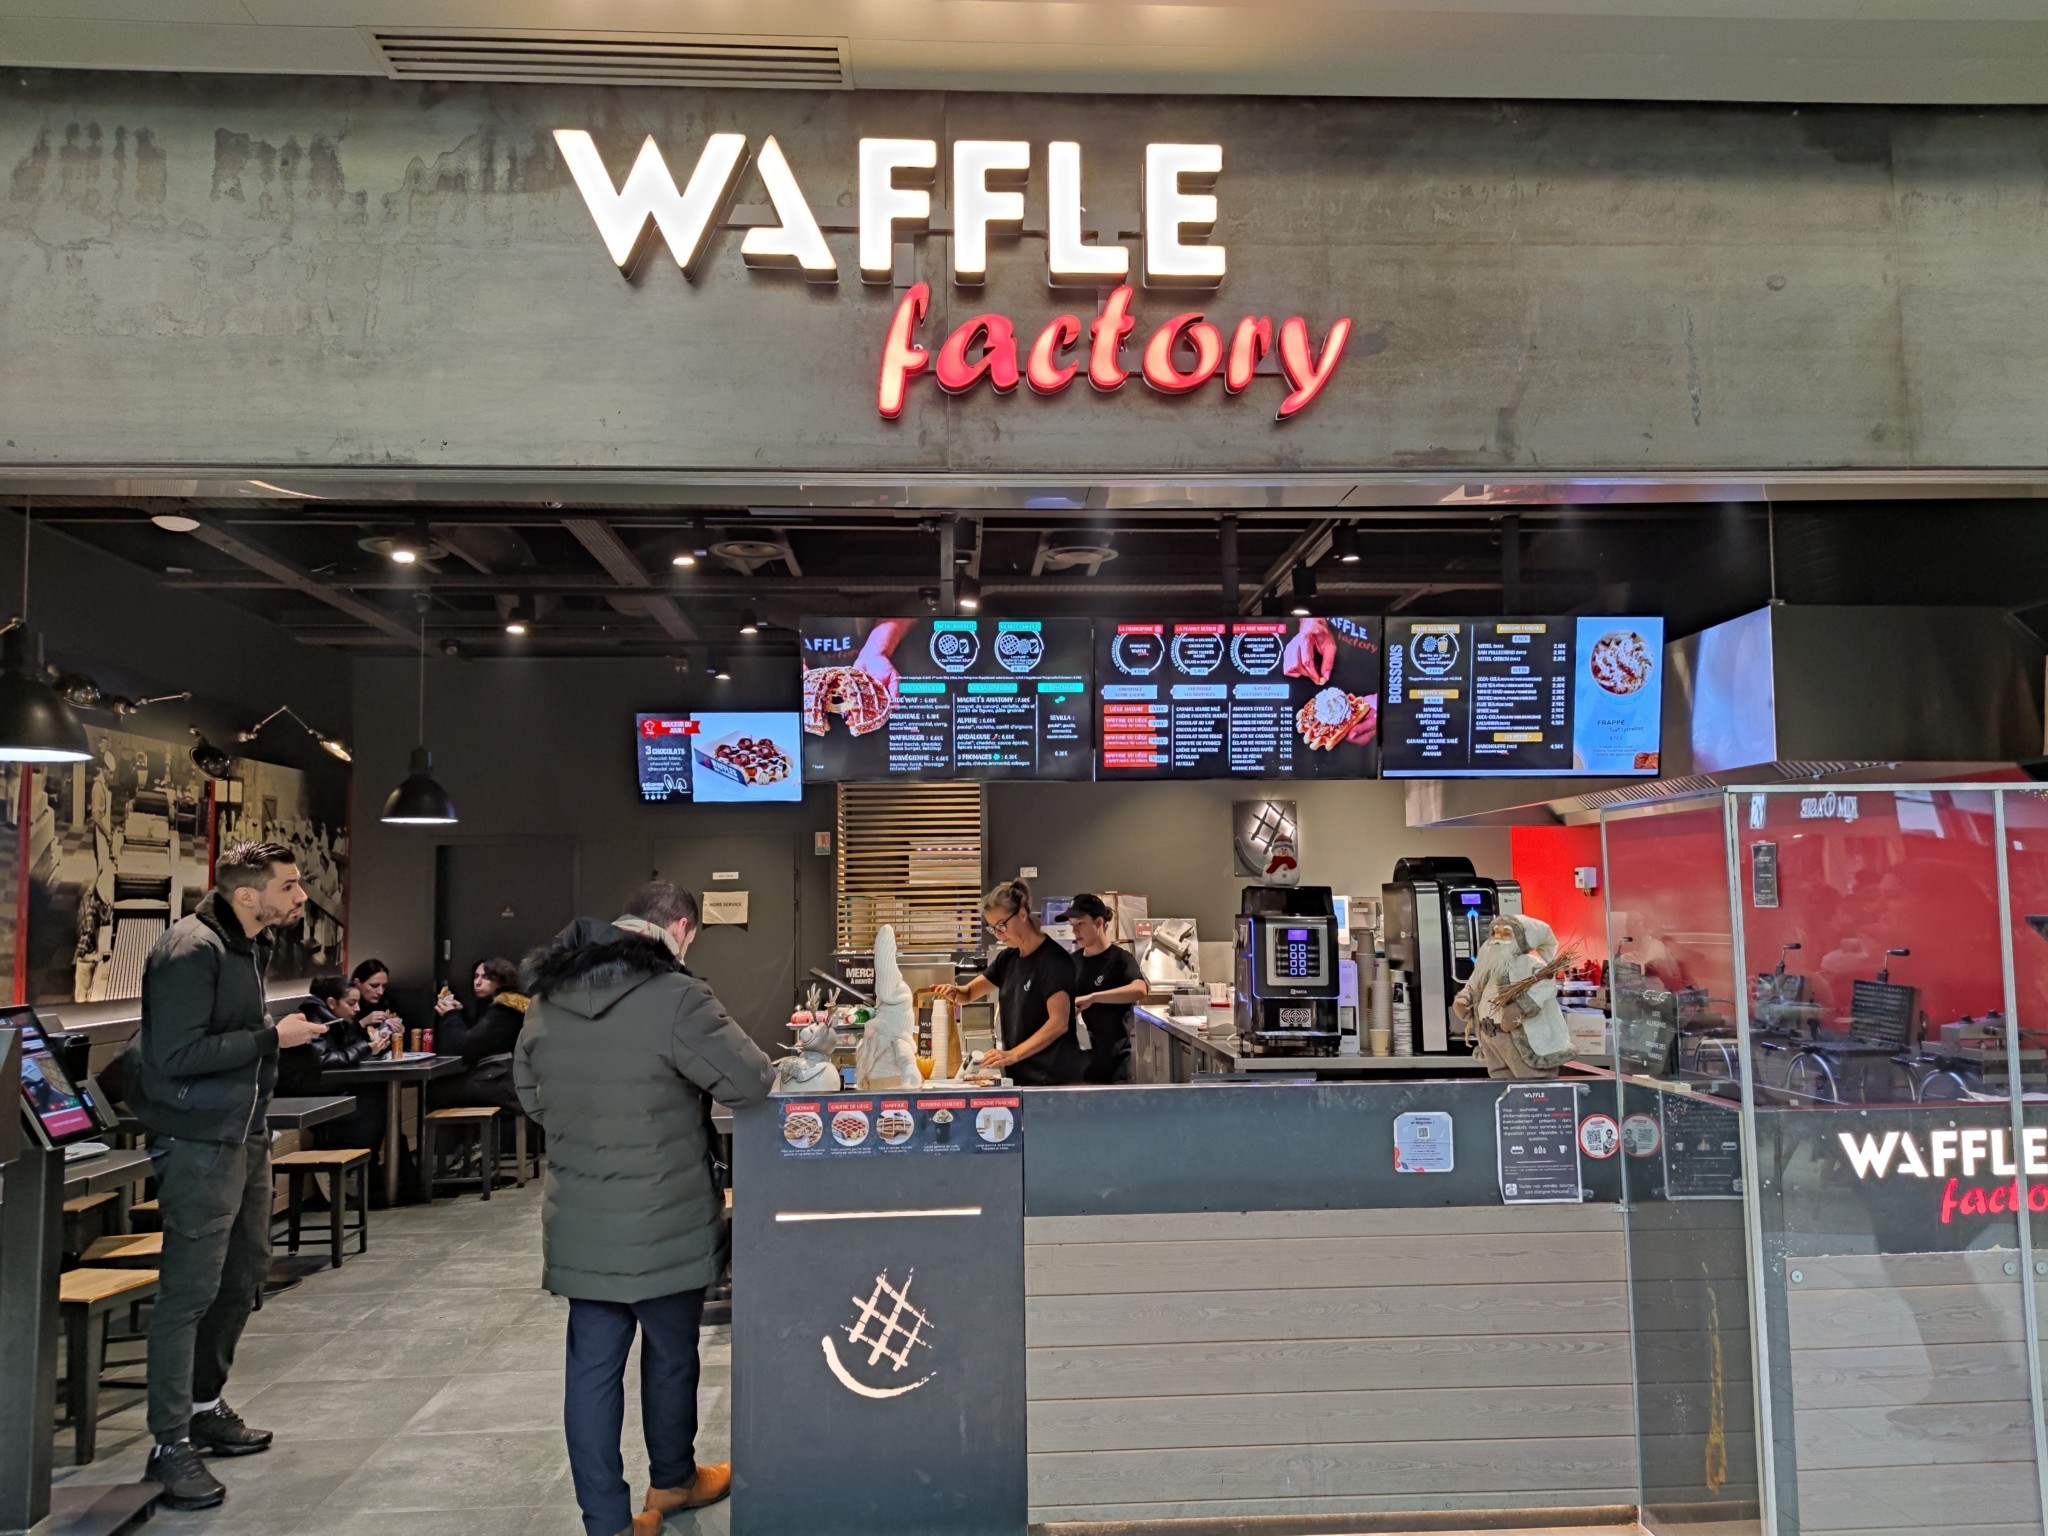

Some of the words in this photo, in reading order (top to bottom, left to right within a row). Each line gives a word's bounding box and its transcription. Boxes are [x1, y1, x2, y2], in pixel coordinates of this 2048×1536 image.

[552, 128, 1227, 288] WAFFLE
[878, 282, 1352, 420] factory
[1327, 617, 1367, 639] AFFLE
[1388, 644, 1403, 703] BOISSONS
[645, 746, 651, 754] 3
[846, 968, 874, 977] MERCI
[1837, 1127, 2048, 1179] WAFFLE
